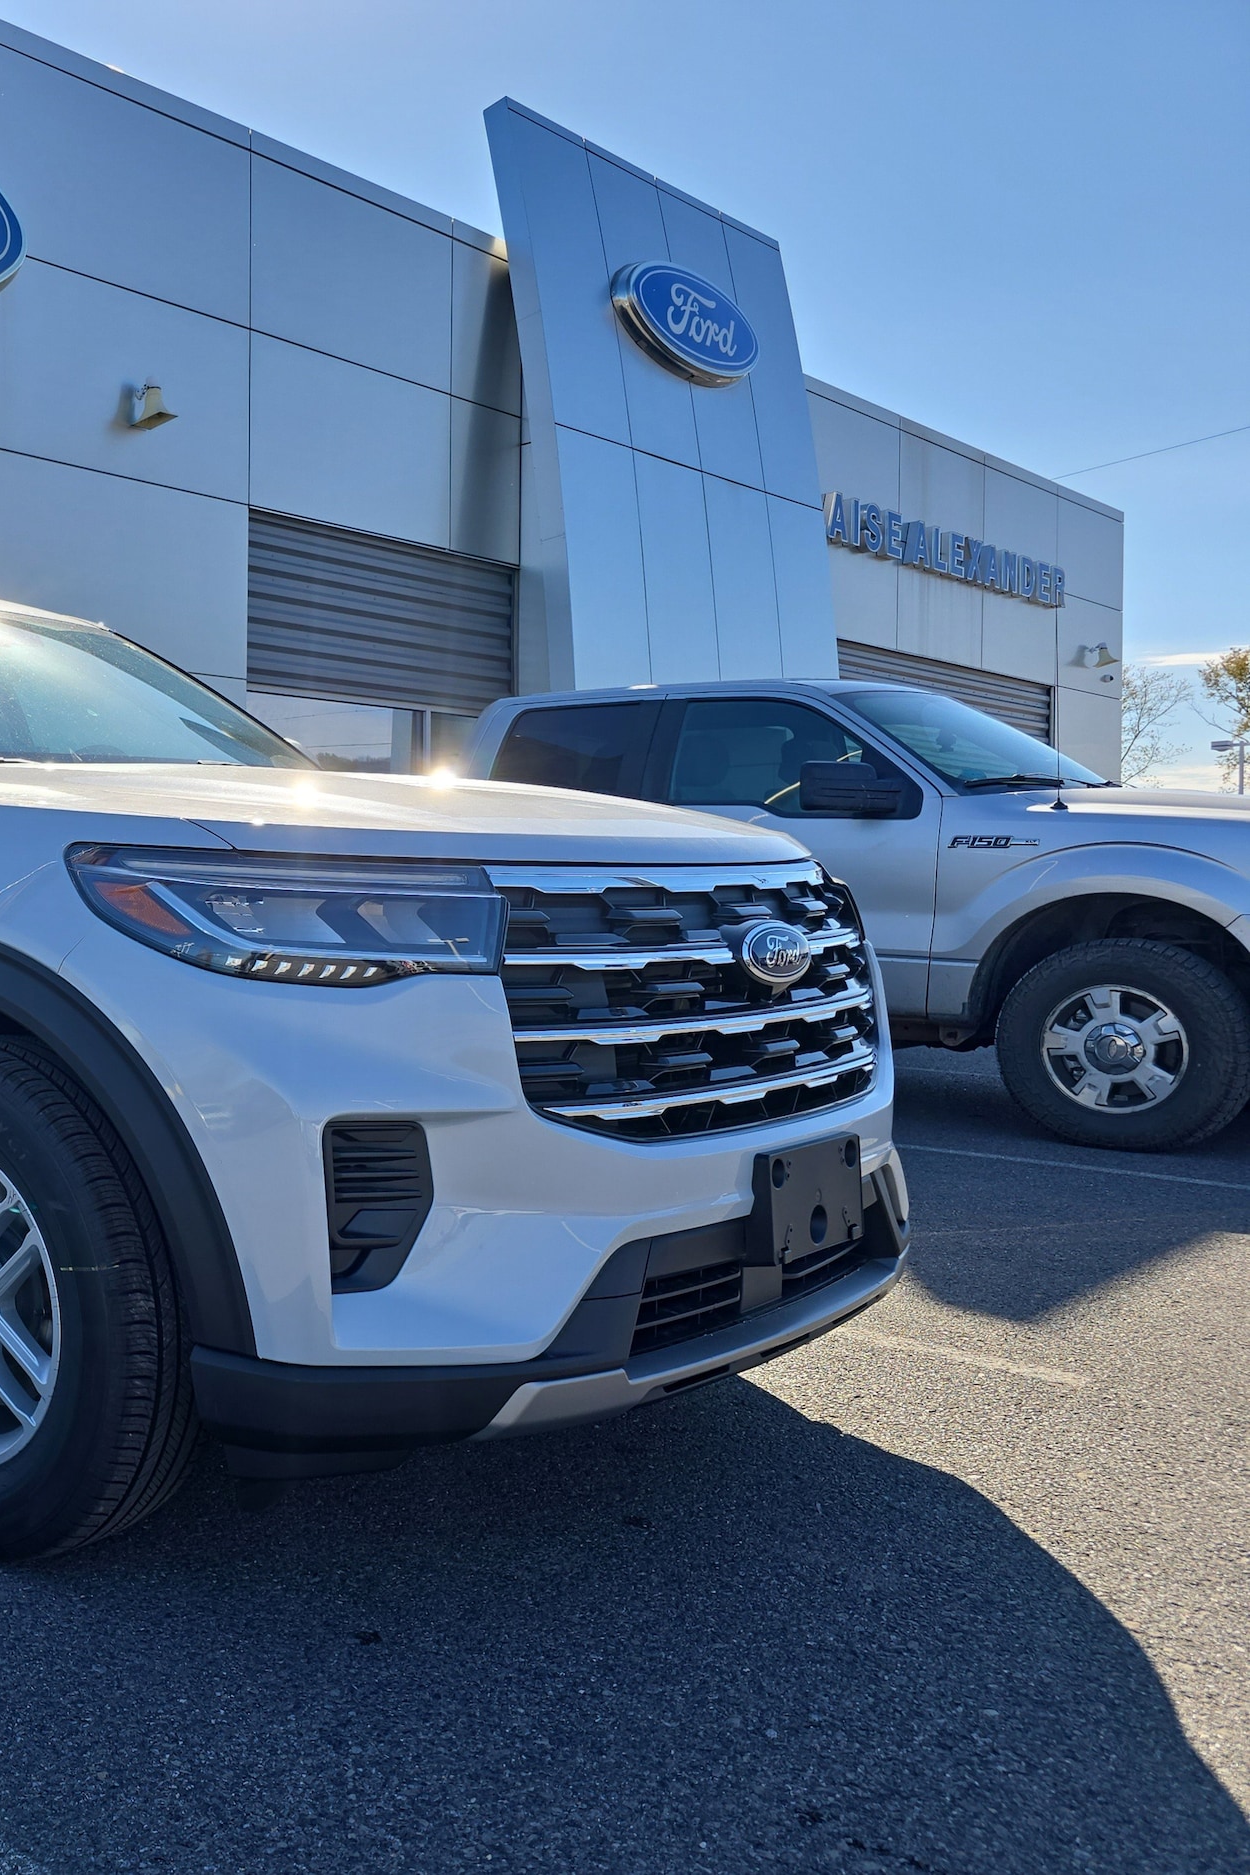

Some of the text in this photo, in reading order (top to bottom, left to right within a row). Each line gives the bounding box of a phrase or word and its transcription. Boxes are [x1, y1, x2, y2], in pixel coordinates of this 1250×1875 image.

[667, 283, 738, 357] Ford
[904, 520, 1066, 608] ALEXANDER
[766, 935, 800, 968] Ford
